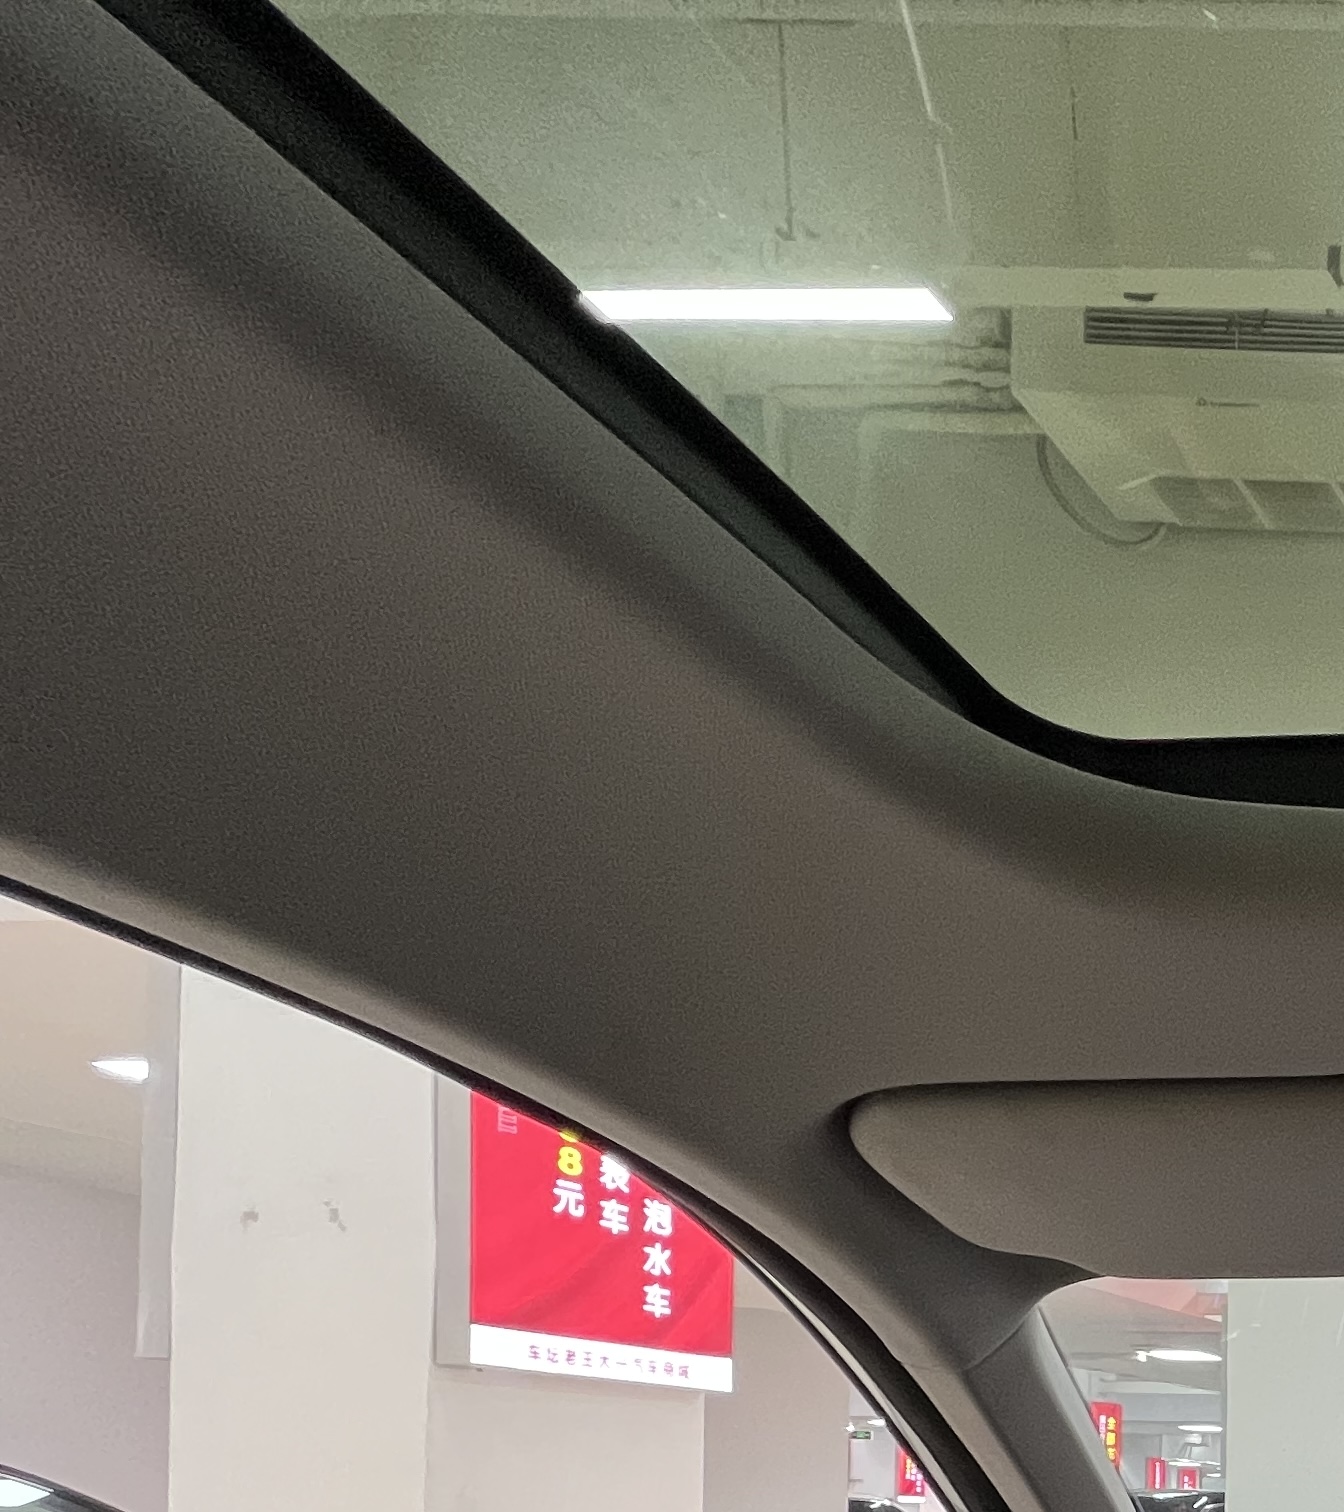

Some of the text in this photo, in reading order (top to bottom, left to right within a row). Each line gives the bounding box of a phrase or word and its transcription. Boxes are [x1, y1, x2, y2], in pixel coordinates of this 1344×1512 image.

[552, 1132, 585, 1218] 8元
[643, 1198, 673, 1318] 泡水车
